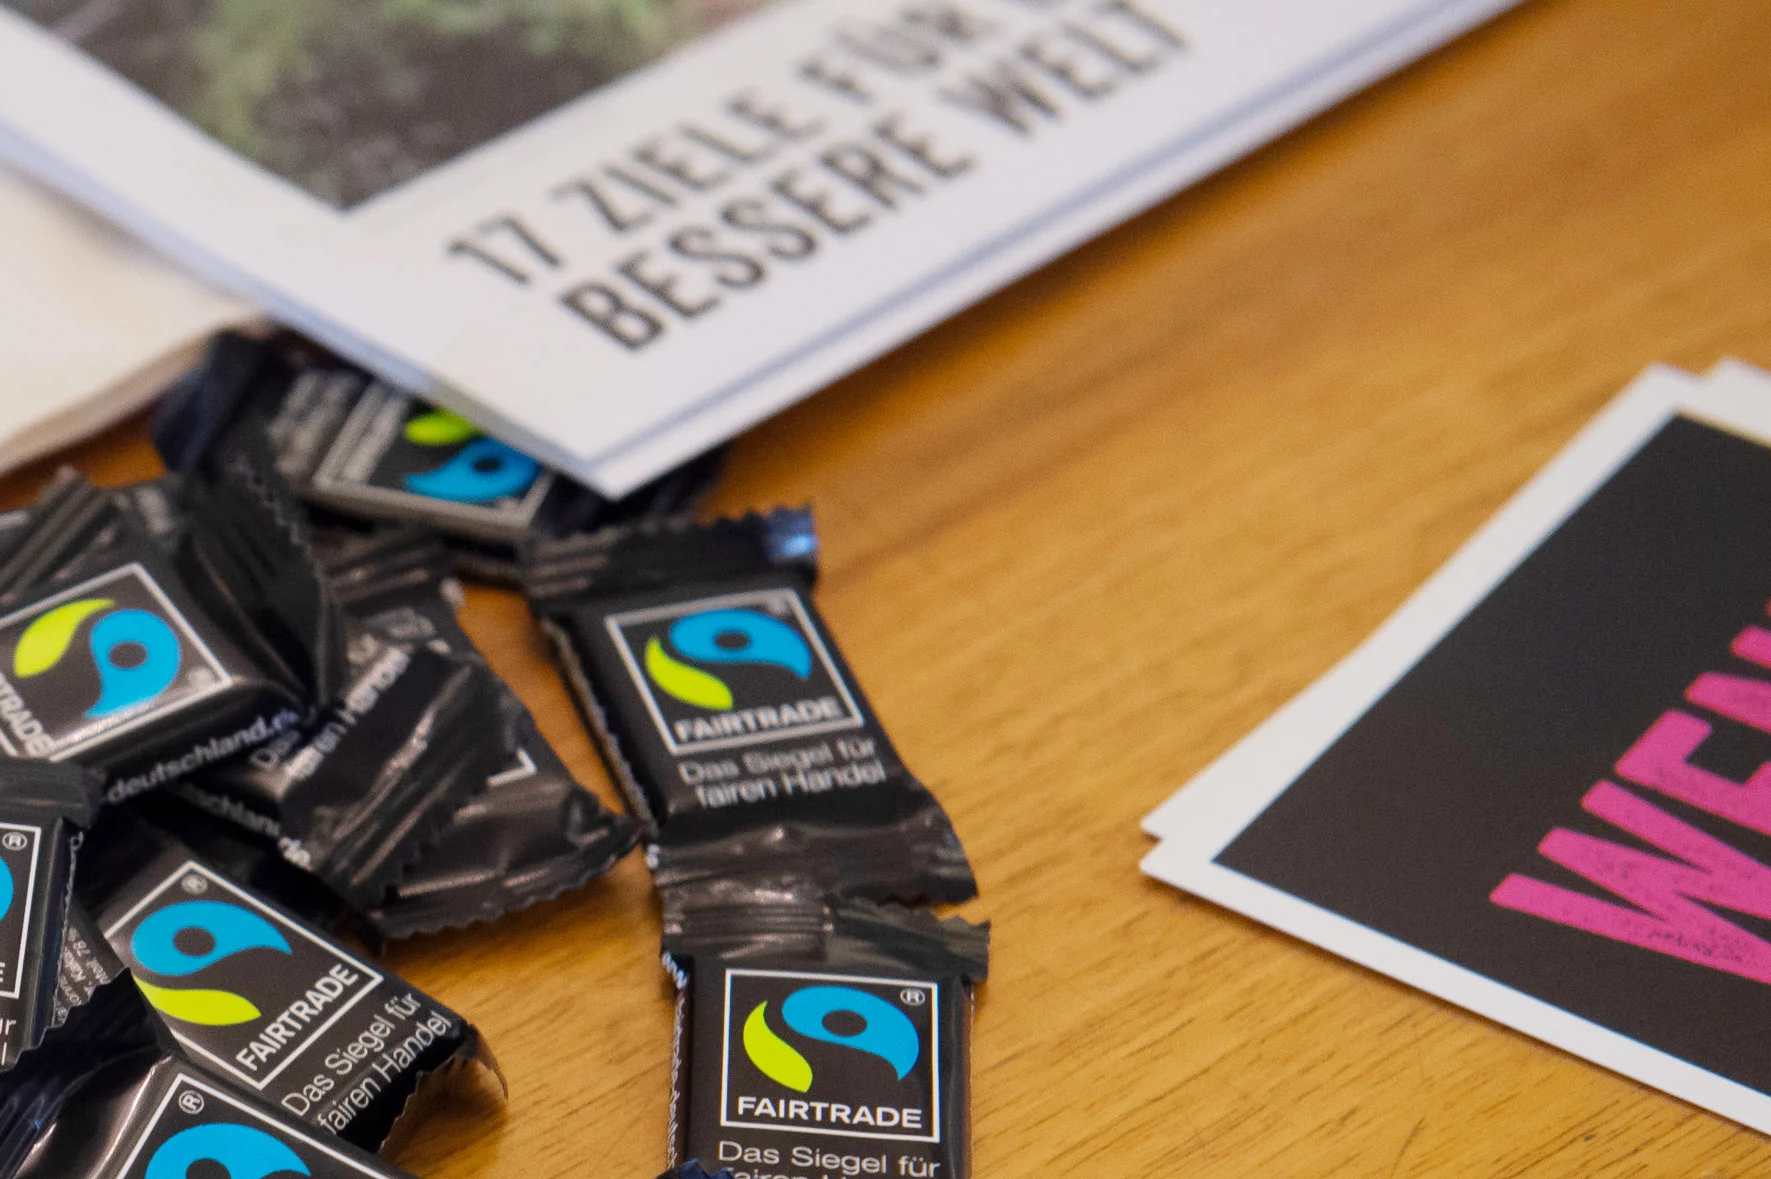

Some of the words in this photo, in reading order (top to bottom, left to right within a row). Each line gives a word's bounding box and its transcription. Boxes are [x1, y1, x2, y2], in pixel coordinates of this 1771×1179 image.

[445, 214, 564, 288] 17
[551, 85, 826, 237] ZIELE
[558, 113, 978, 353] BESSERE
[938, 0, 1189, 139] WELT
[673, 697, 842, 744] FAIRTRADE
[678, 758, 739, 786] Das
[744, 746, 832, 779] Siegel
[695, 777, 777, 808] fairen
[784, 761, 886, 796] Handel
[236, 963, 358, 1071] FAIRTRADE
[281, 1074, 337, 1118] Das
[325, 1009, 397, 1077] Siegel
[386, 991, 423, 1021] für
[317, 1073, 381, 1135] fairen
[378, 1011, 453, 1078] Handel
[737, 1095, 923, 1129] FAIRTRADE
[719, 1141, 779, 1164] Das
[791, 1147, 886, 1176] Siegel
[899, 1156, 940, 1179] für
